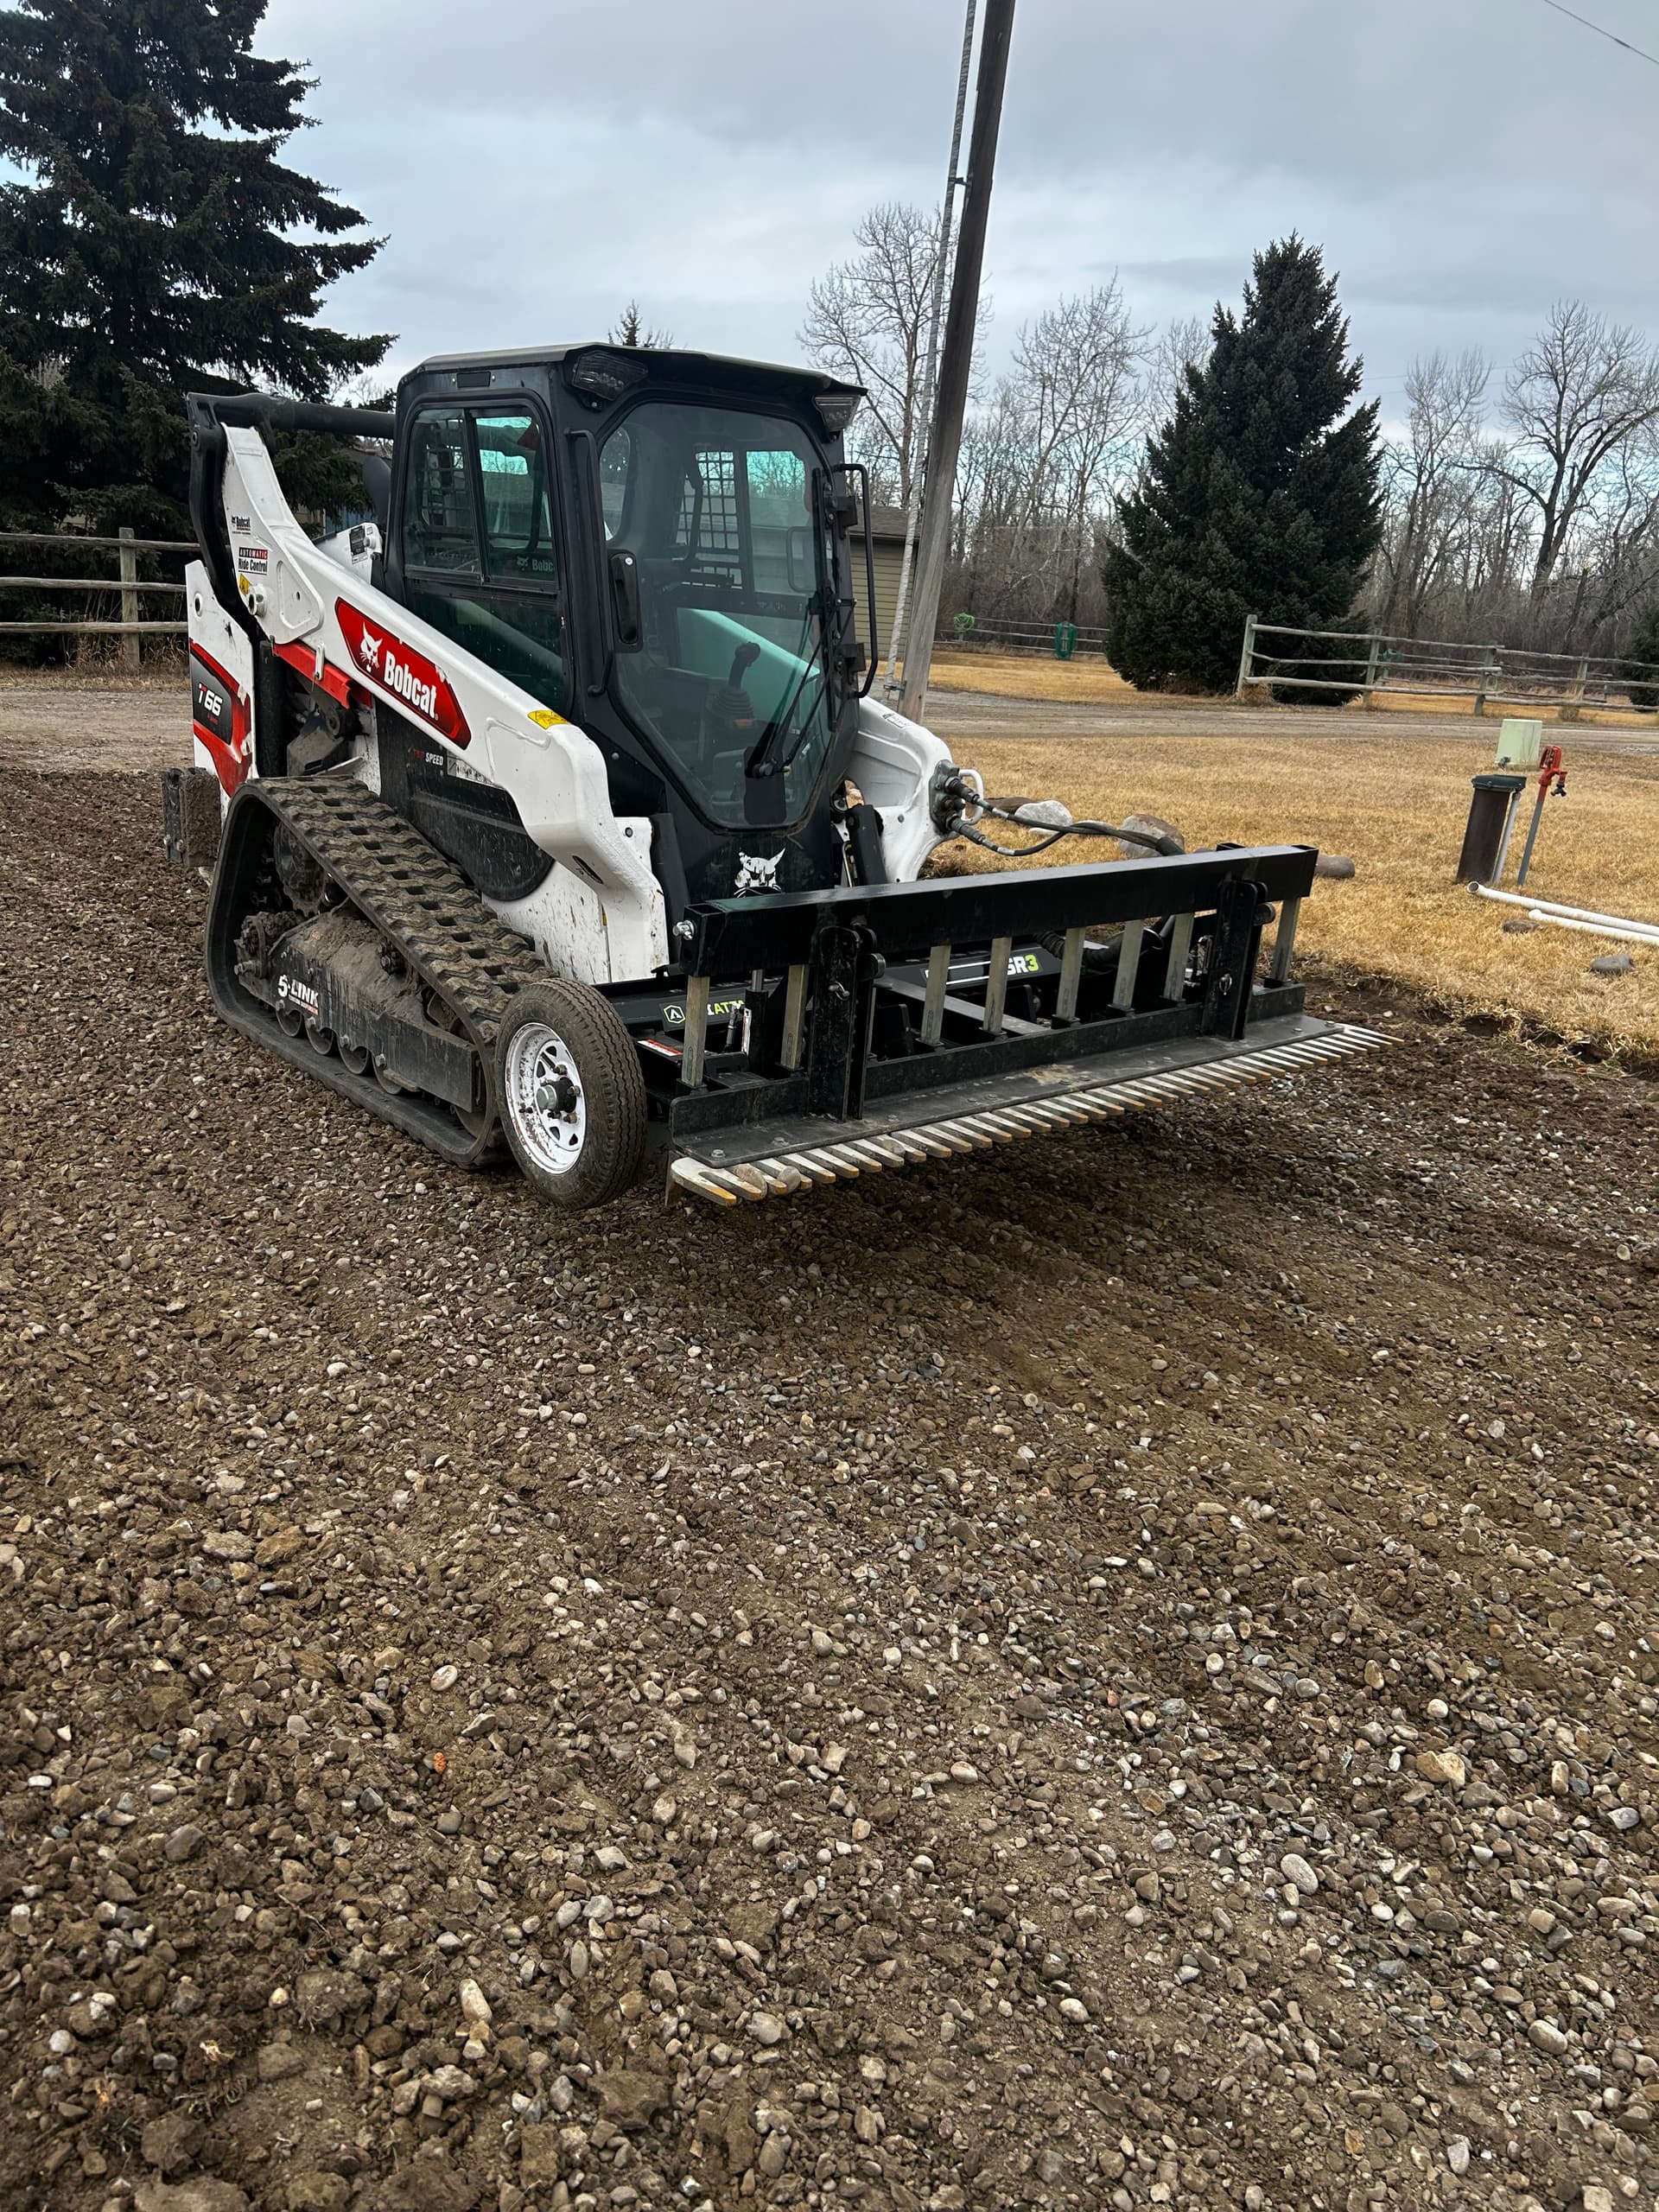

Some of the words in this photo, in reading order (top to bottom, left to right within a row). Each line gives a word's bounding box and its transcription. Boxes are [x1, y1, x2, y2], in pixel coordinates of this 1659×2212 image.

[238, 558, 249, 570] Ride
[250, 559, 268, 573] Control
[240, 548, 267, 559] AUTOMATIC
[384, 650, 437, 719] Bobcat
[199, 683, 223, 716] T66
[425, 752, 444, 766] SPEED
[277, 974, 319, 1008] 5-LINK
